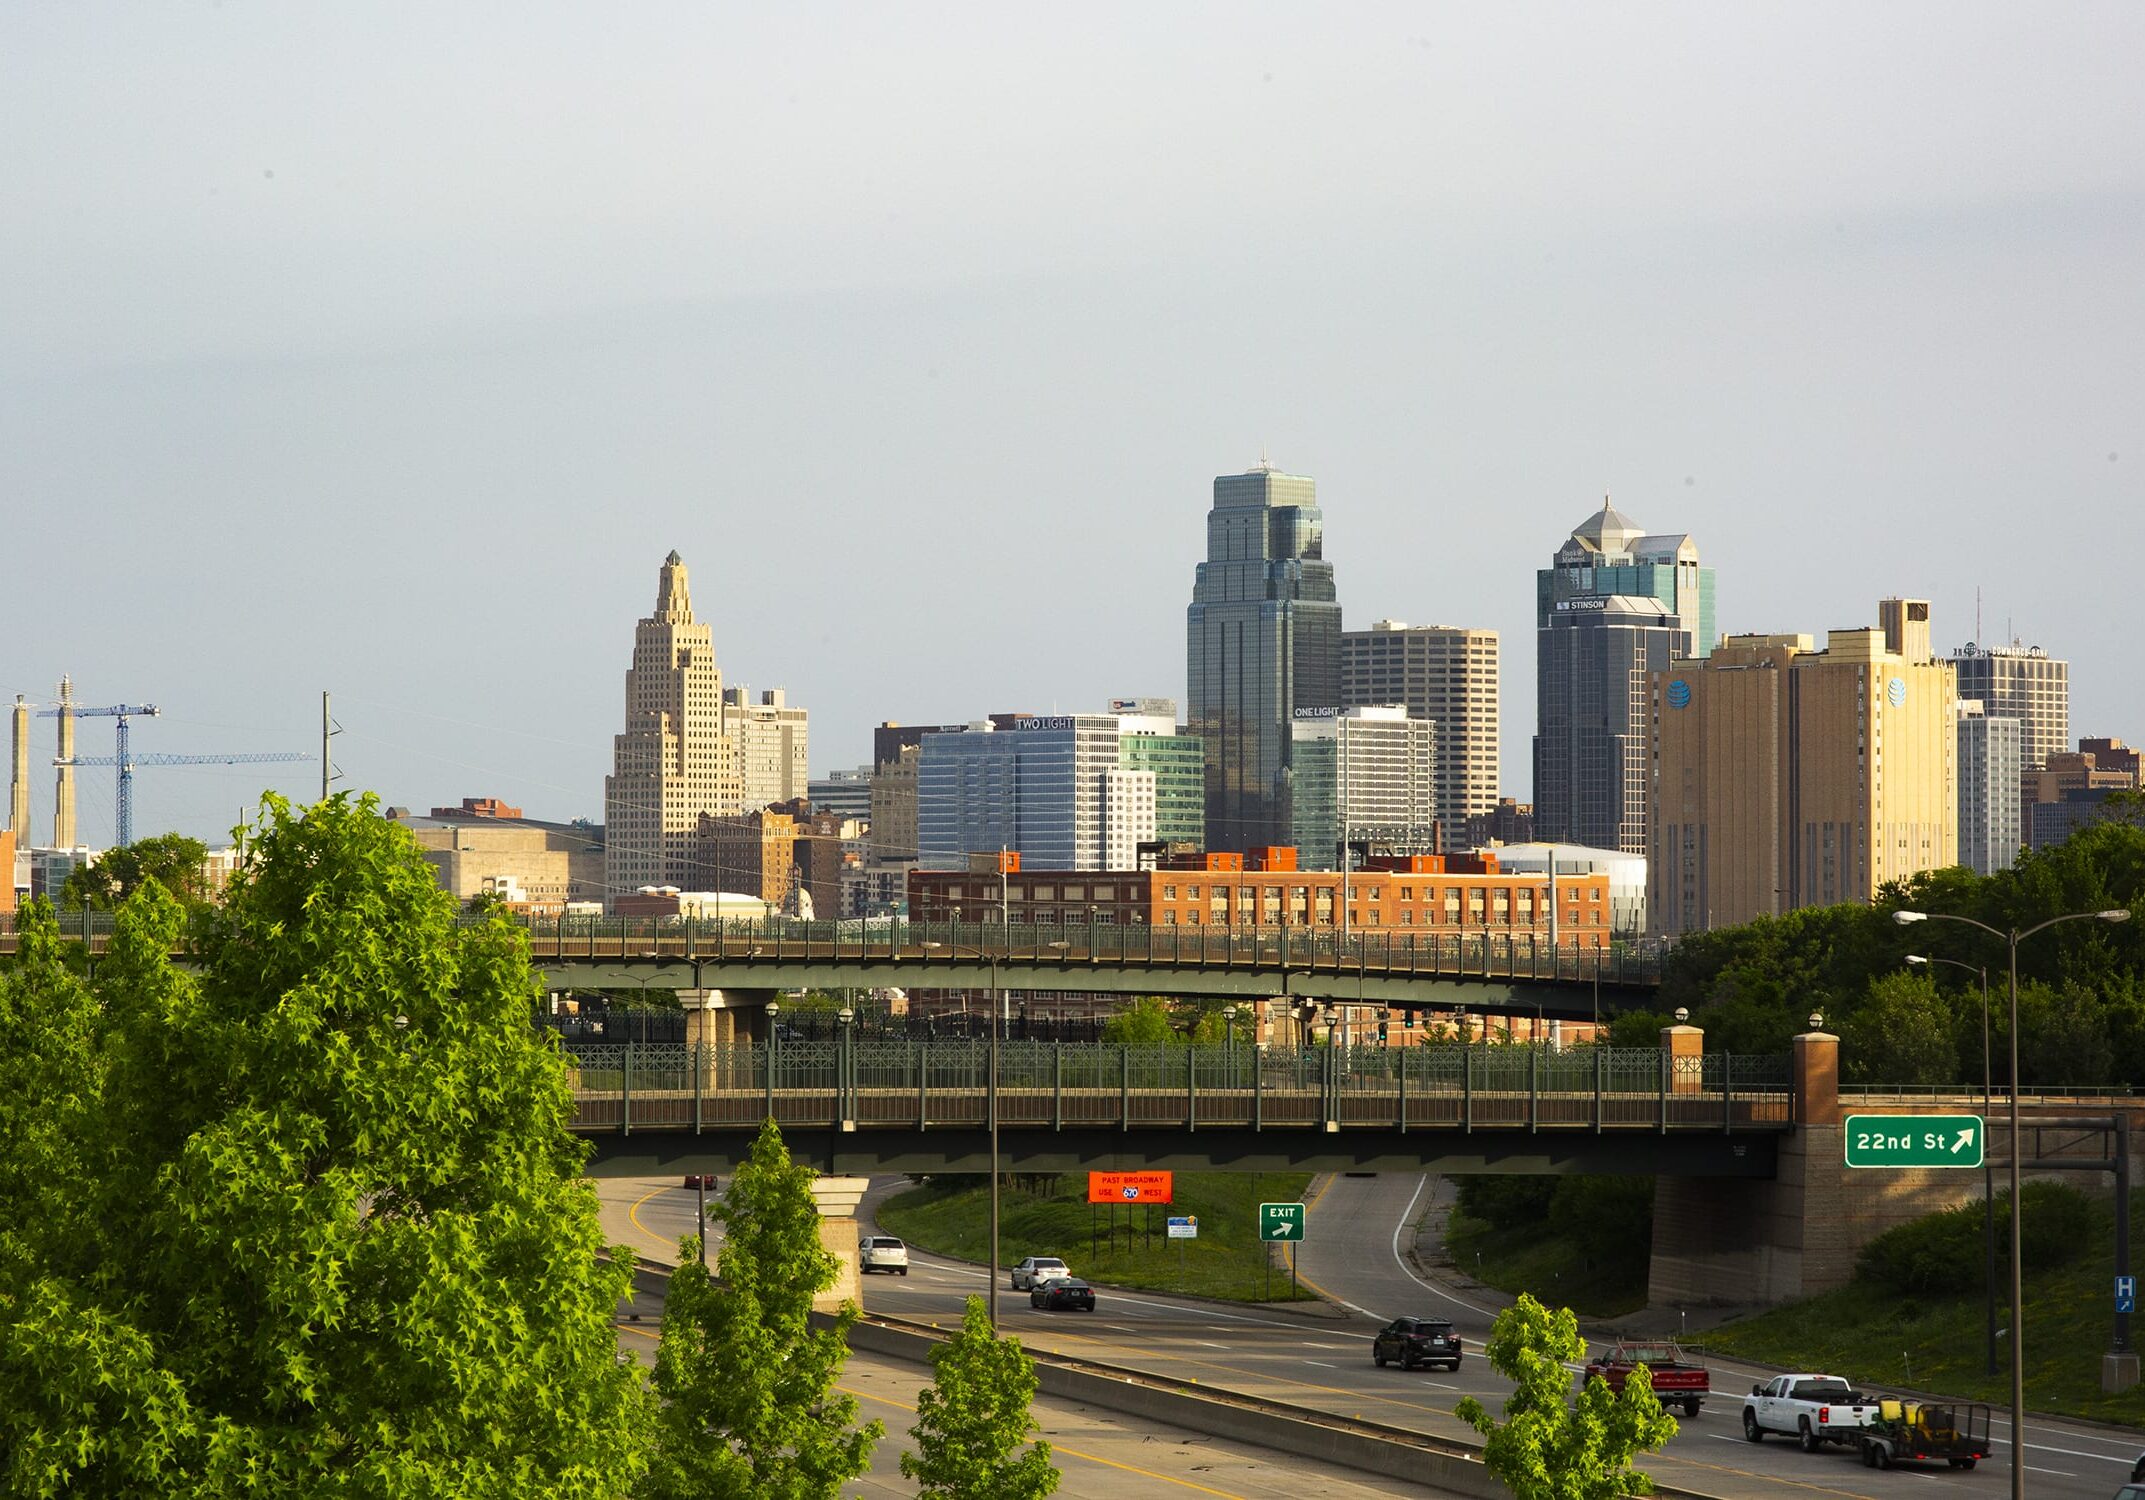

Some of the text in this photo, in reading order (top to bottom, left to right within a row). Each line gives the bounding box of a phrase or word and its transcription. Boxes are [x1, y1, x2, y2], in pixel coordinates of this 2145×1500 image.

[1571, 601, 1605, 609] STINSON
[1295, 706, 1339, 717] ONE LIGHT
[1016, 717, 1073, 729] TWO LIGHT
[1857, 1133, 1945, 1149] 22nd St
[1102, 1175, 1164, 1184] PAST BROADWAY
[1123, 1188, 1138, 1197] 670
[1270, 1208, 1295, 1217] EXIT
[2118, 1278, 2133, 1297] H
